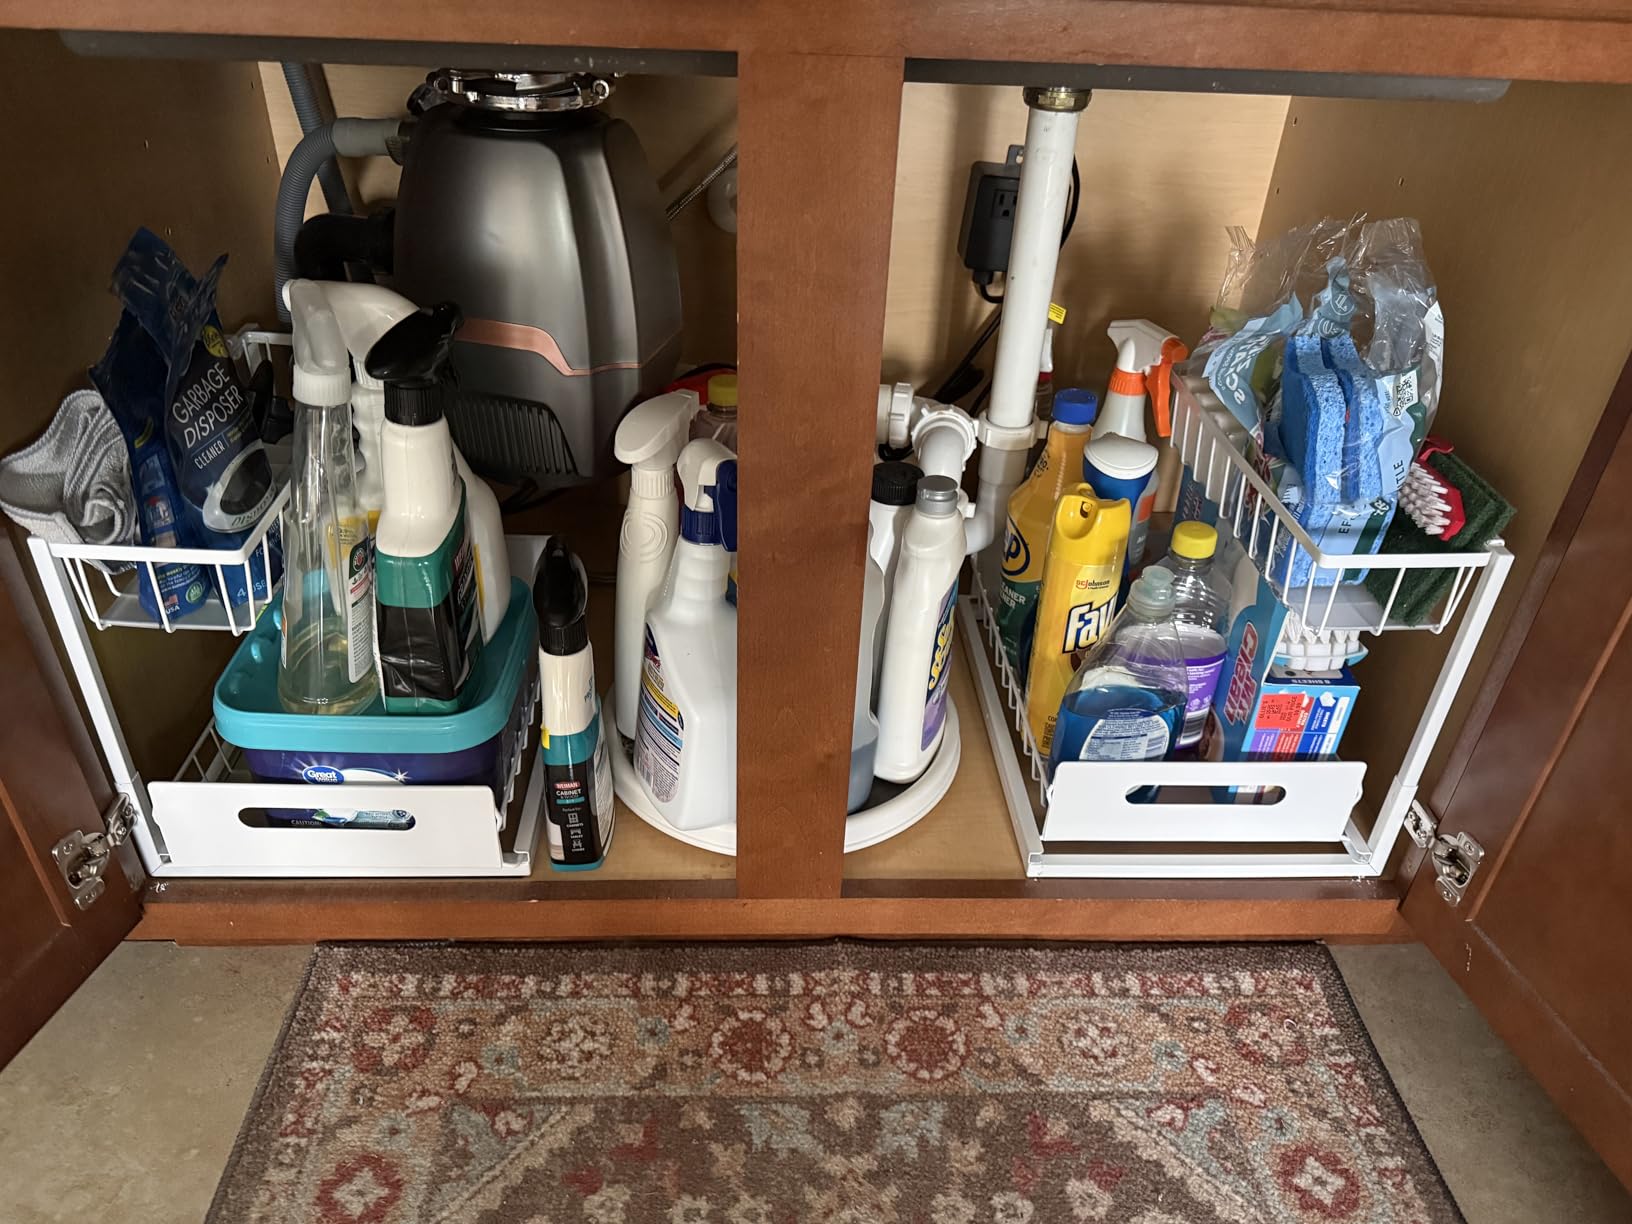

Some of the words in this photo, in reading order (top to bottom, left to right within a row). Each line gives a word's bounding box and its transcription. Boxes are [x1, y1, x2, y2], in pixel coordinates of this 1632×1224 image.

[172, 362, 230, 424] GARBAGE
[183, 385, 244, 449] DISPOSER
[194, 440, 226, 470] CLEANER
[237, 587, 247, 597] 4
[165, 604, 181, 615] USA
[1223, 621, 1258, 726] Clean
[307, 769, 337, 779] Great
[556, 788, 581, 796] CABINET
